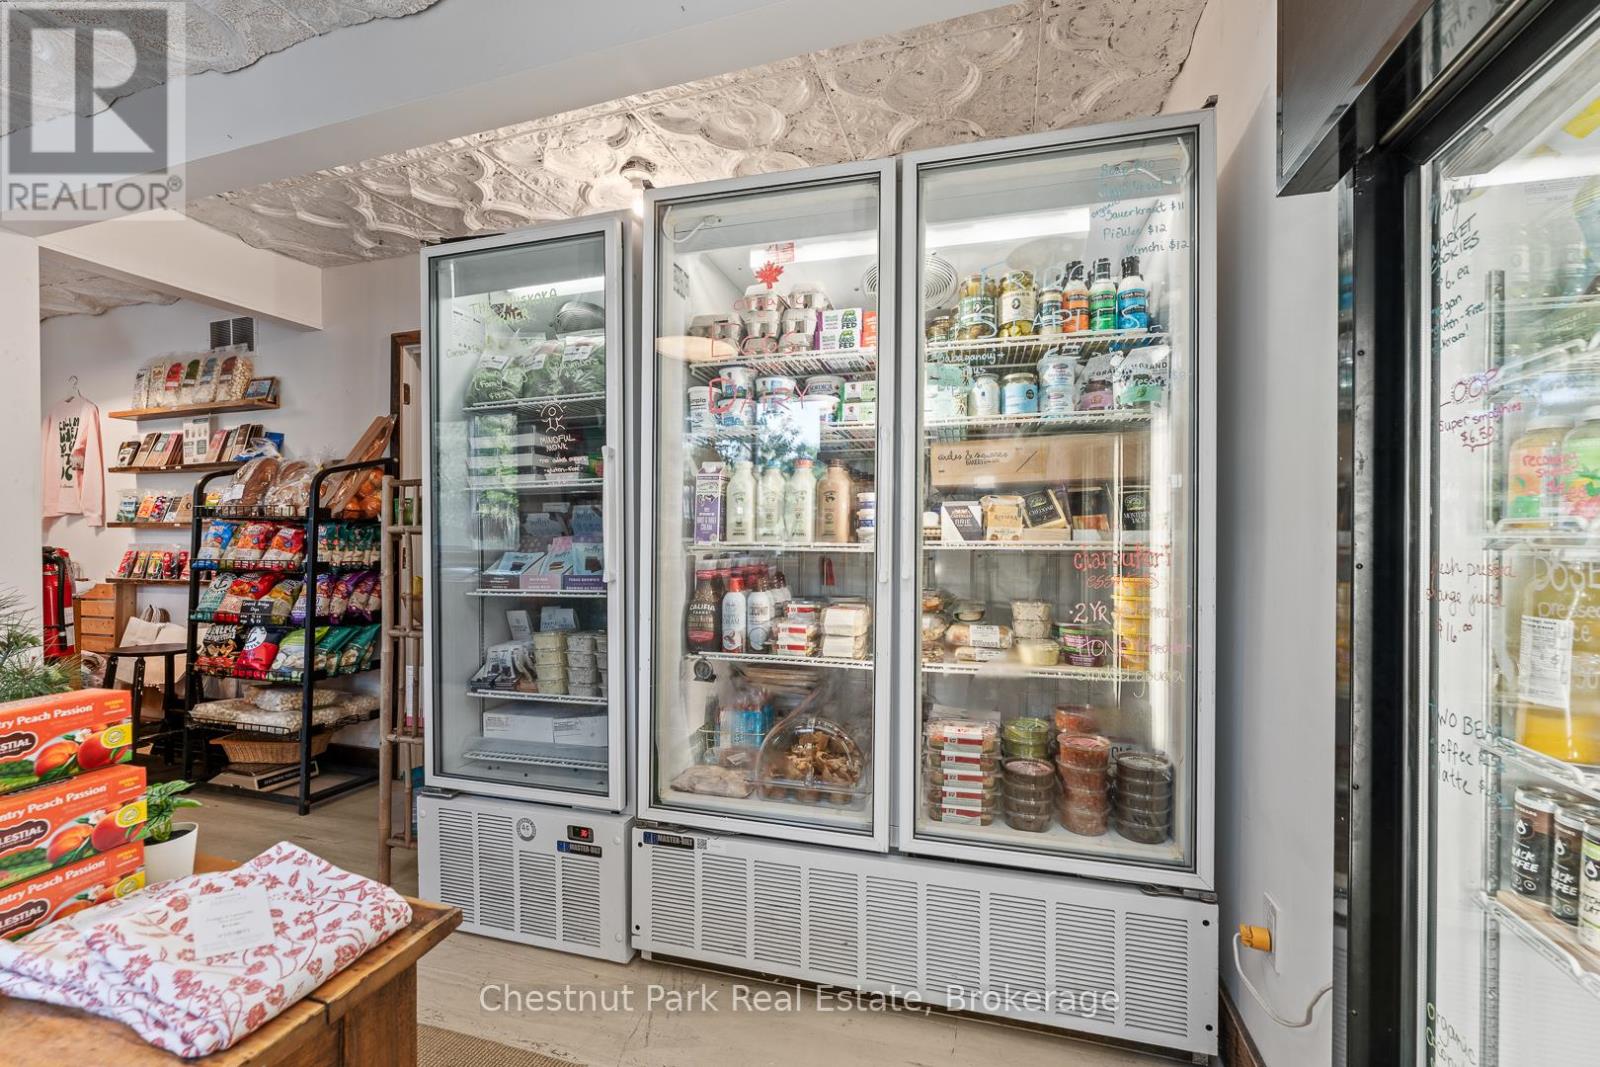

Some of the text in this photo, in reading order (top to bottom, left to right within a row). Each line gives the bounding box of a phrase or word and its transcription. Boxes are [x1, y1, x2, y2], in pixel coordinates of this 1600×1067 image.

[1147, 223, 1168, 234] $12
[1168, 239, 1190, 250] $12
[16, 711, 52, 726] Peach
[53, 703, 93, 719] Passion
[28, 796, 64, 814] Peach
[65, 784, 107, 803] Passion
[28, 874, 64, 895] Peach
[64, 859, 106, 881] Passion
